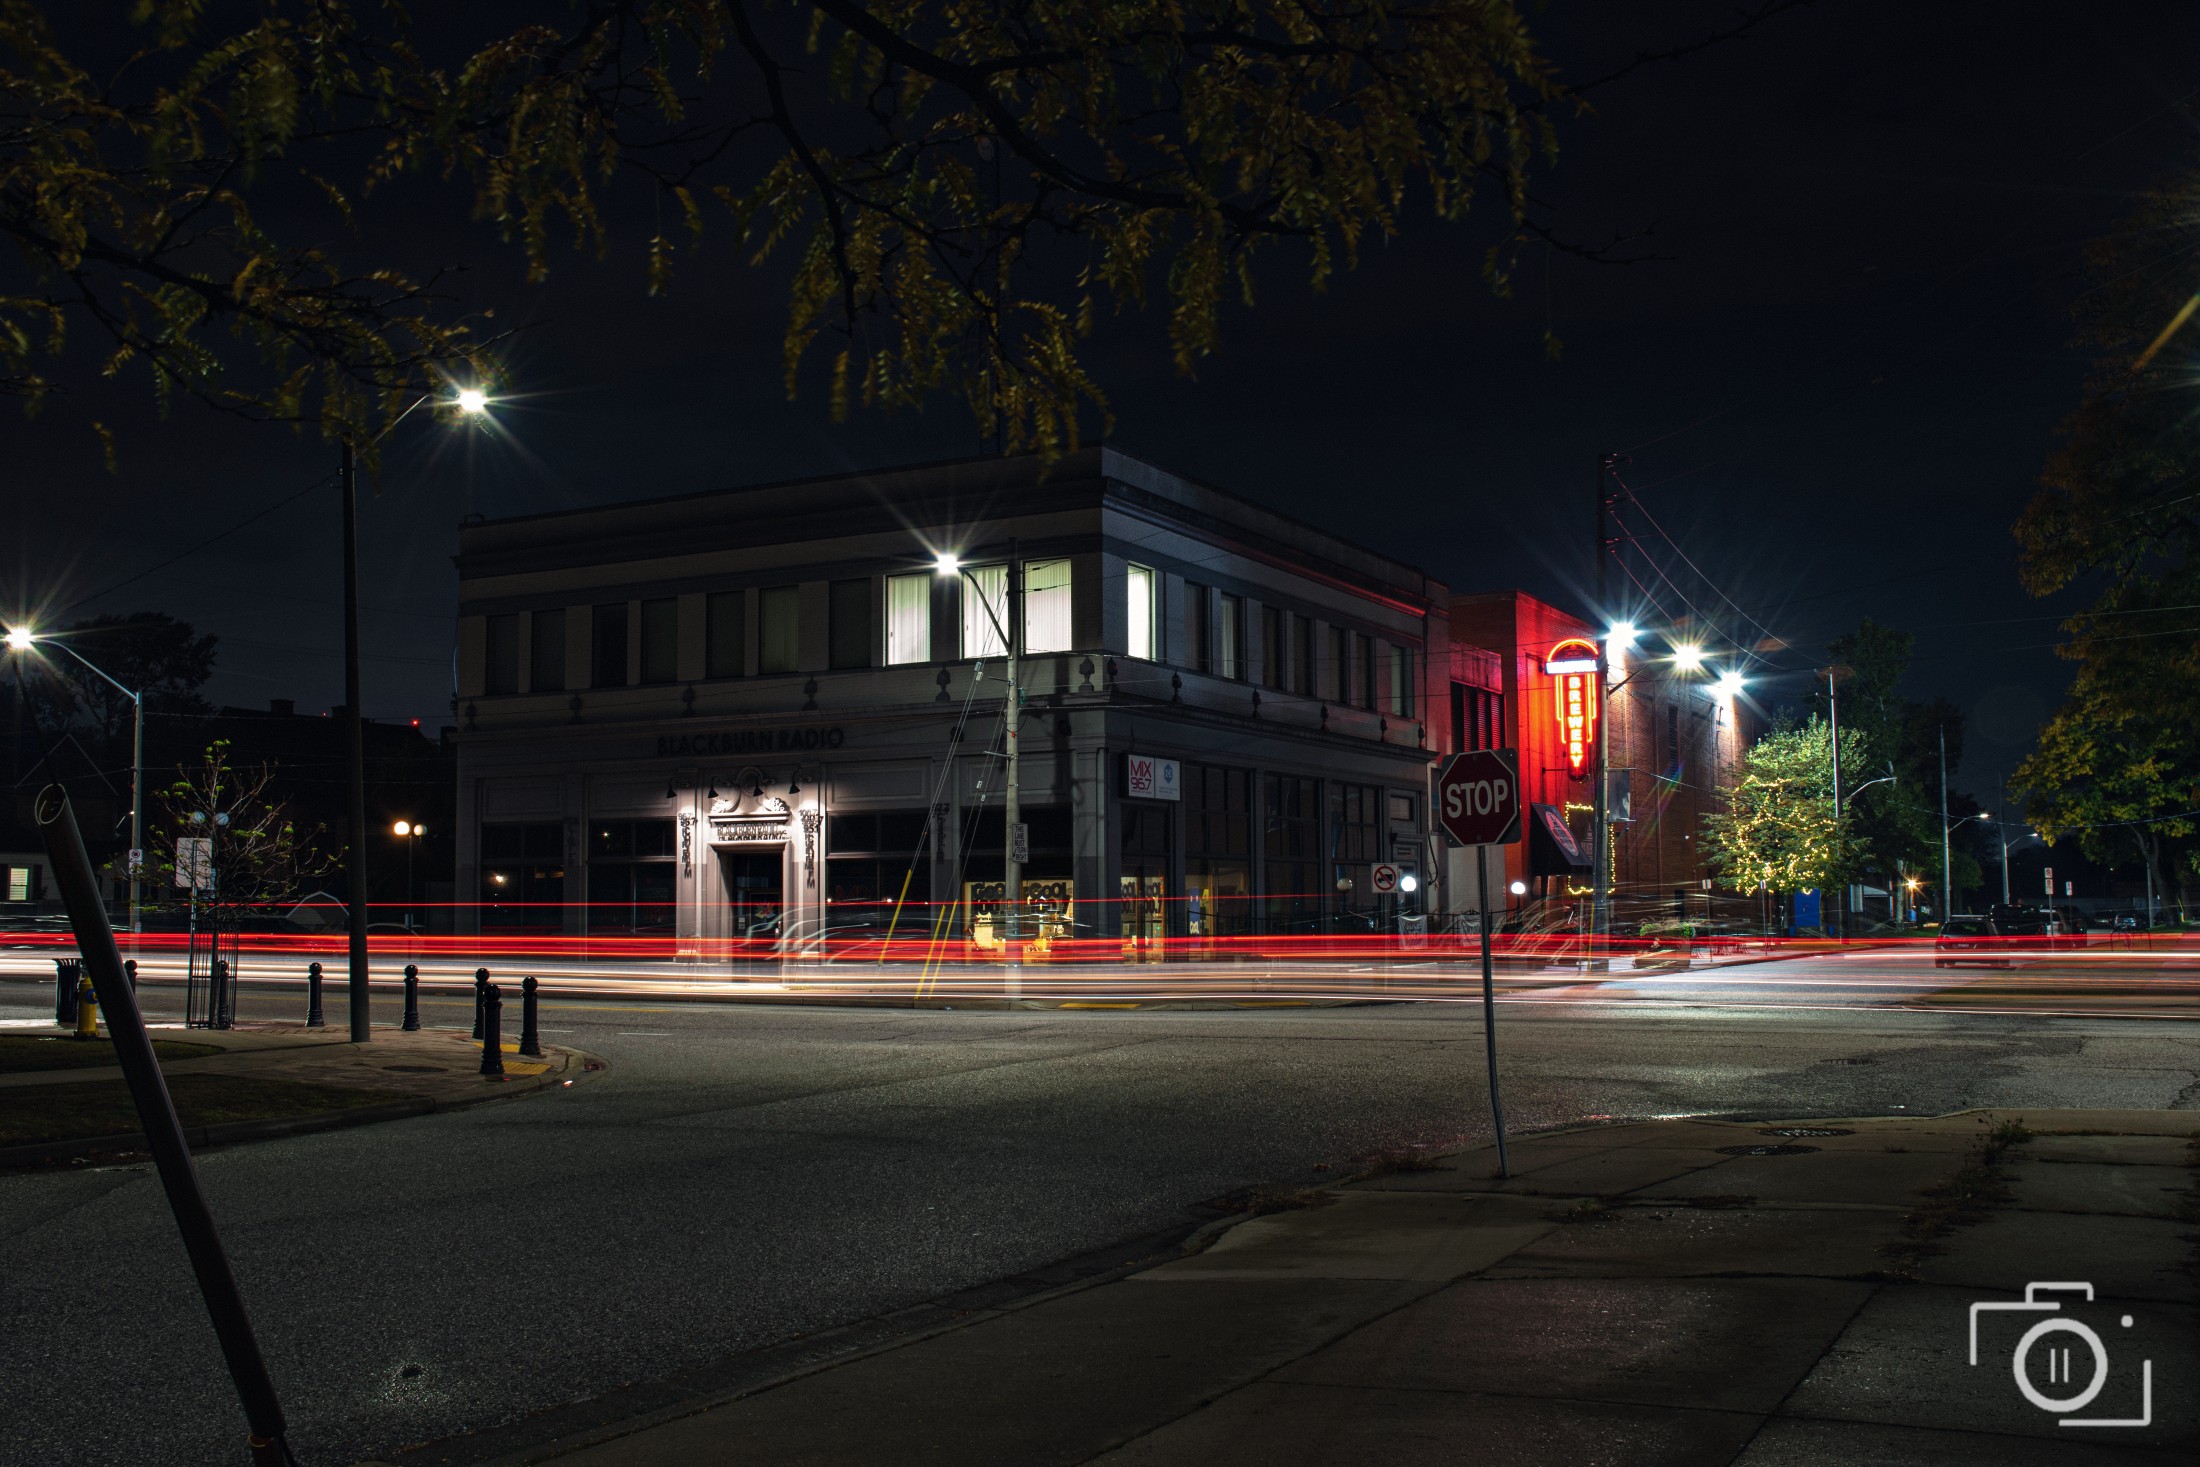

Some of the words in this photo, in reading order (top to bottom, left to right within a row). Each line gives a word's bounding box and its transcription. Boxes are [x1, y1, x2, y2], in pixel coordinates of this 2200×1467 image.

[1567, 676, 1584, 768] BREWERY
[657, 730, 773, 757] BLACKBURN
[779, 727, 844, 751] RADIO
[1130, 759, 1152, 778] MIX
[1446, 778, 1508, 819] STOP
